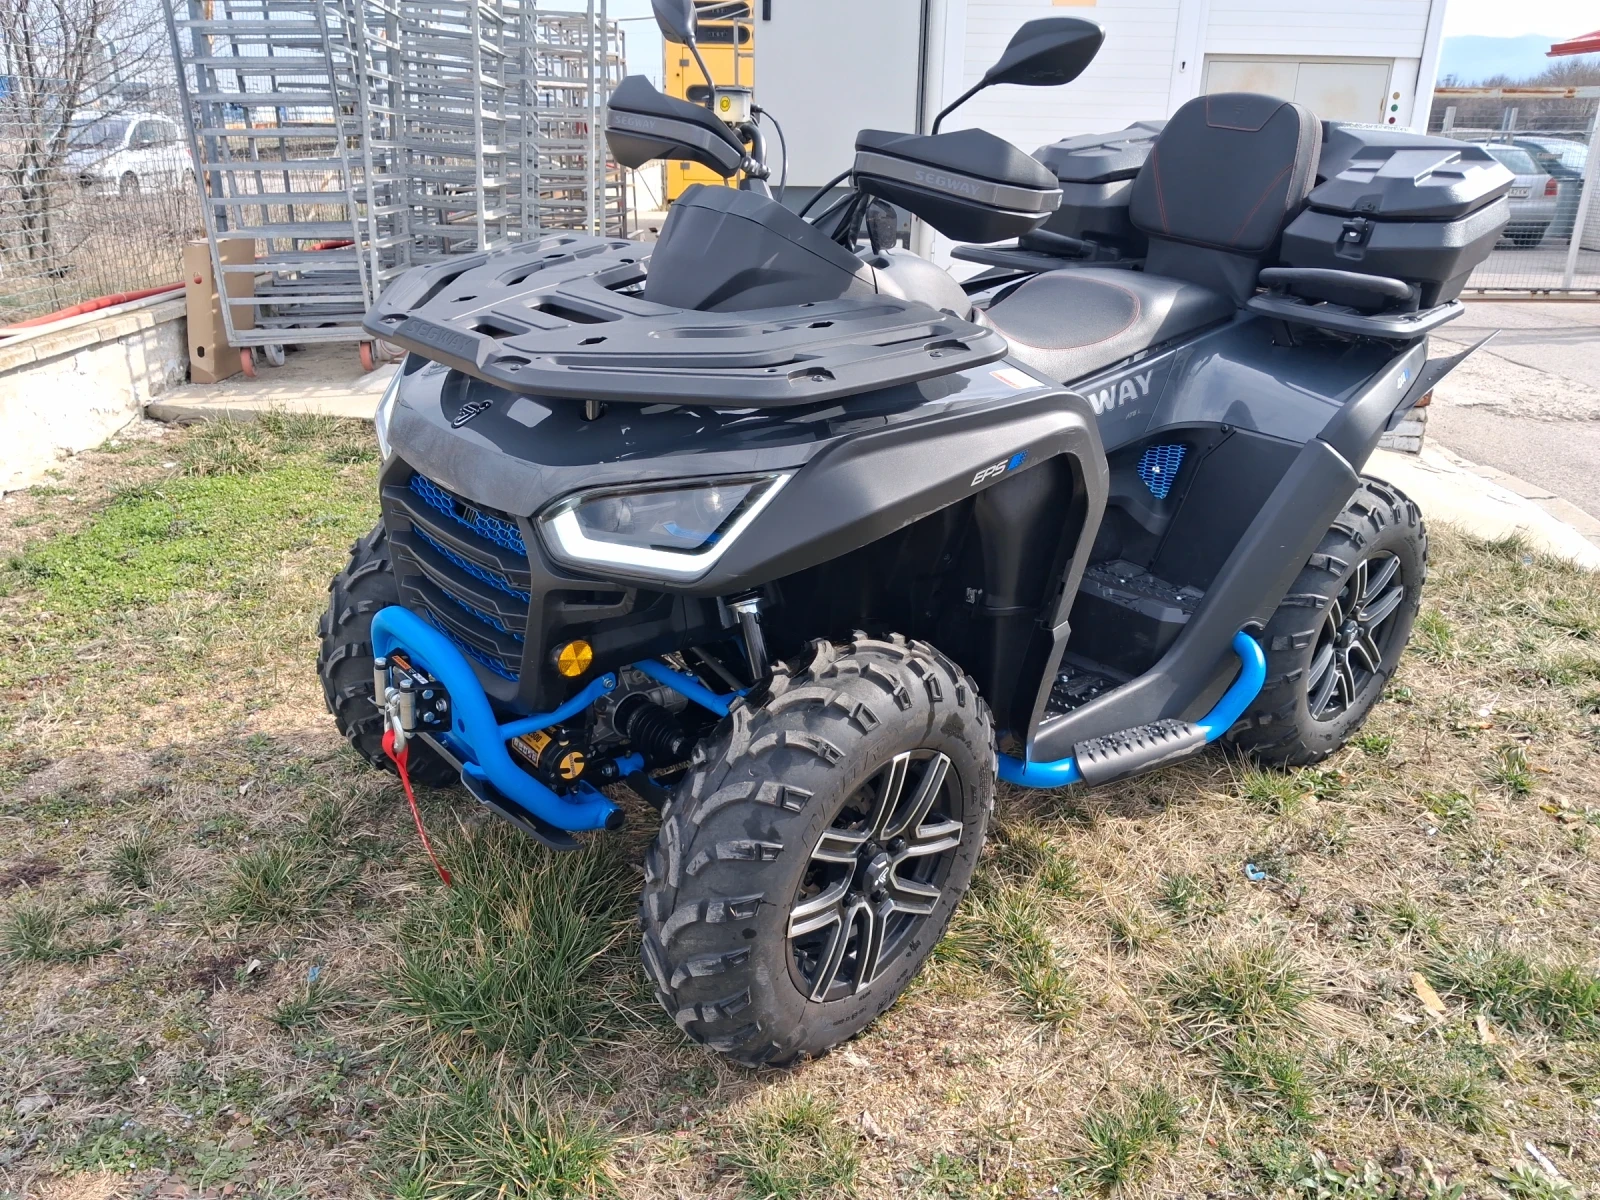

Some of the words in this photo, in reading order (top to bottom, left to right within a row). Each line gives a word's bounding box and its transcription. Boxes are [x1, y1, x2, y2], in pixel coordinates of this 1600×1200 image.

[615, 115, 656, 129] SEGWAY
[915, 169, 981, 196] SEGWAY
[406, 320, 472, 351] SEGWAY
[1087, 368, 1154, 415] WAY
[970, 459, 1009, 487] EPS
